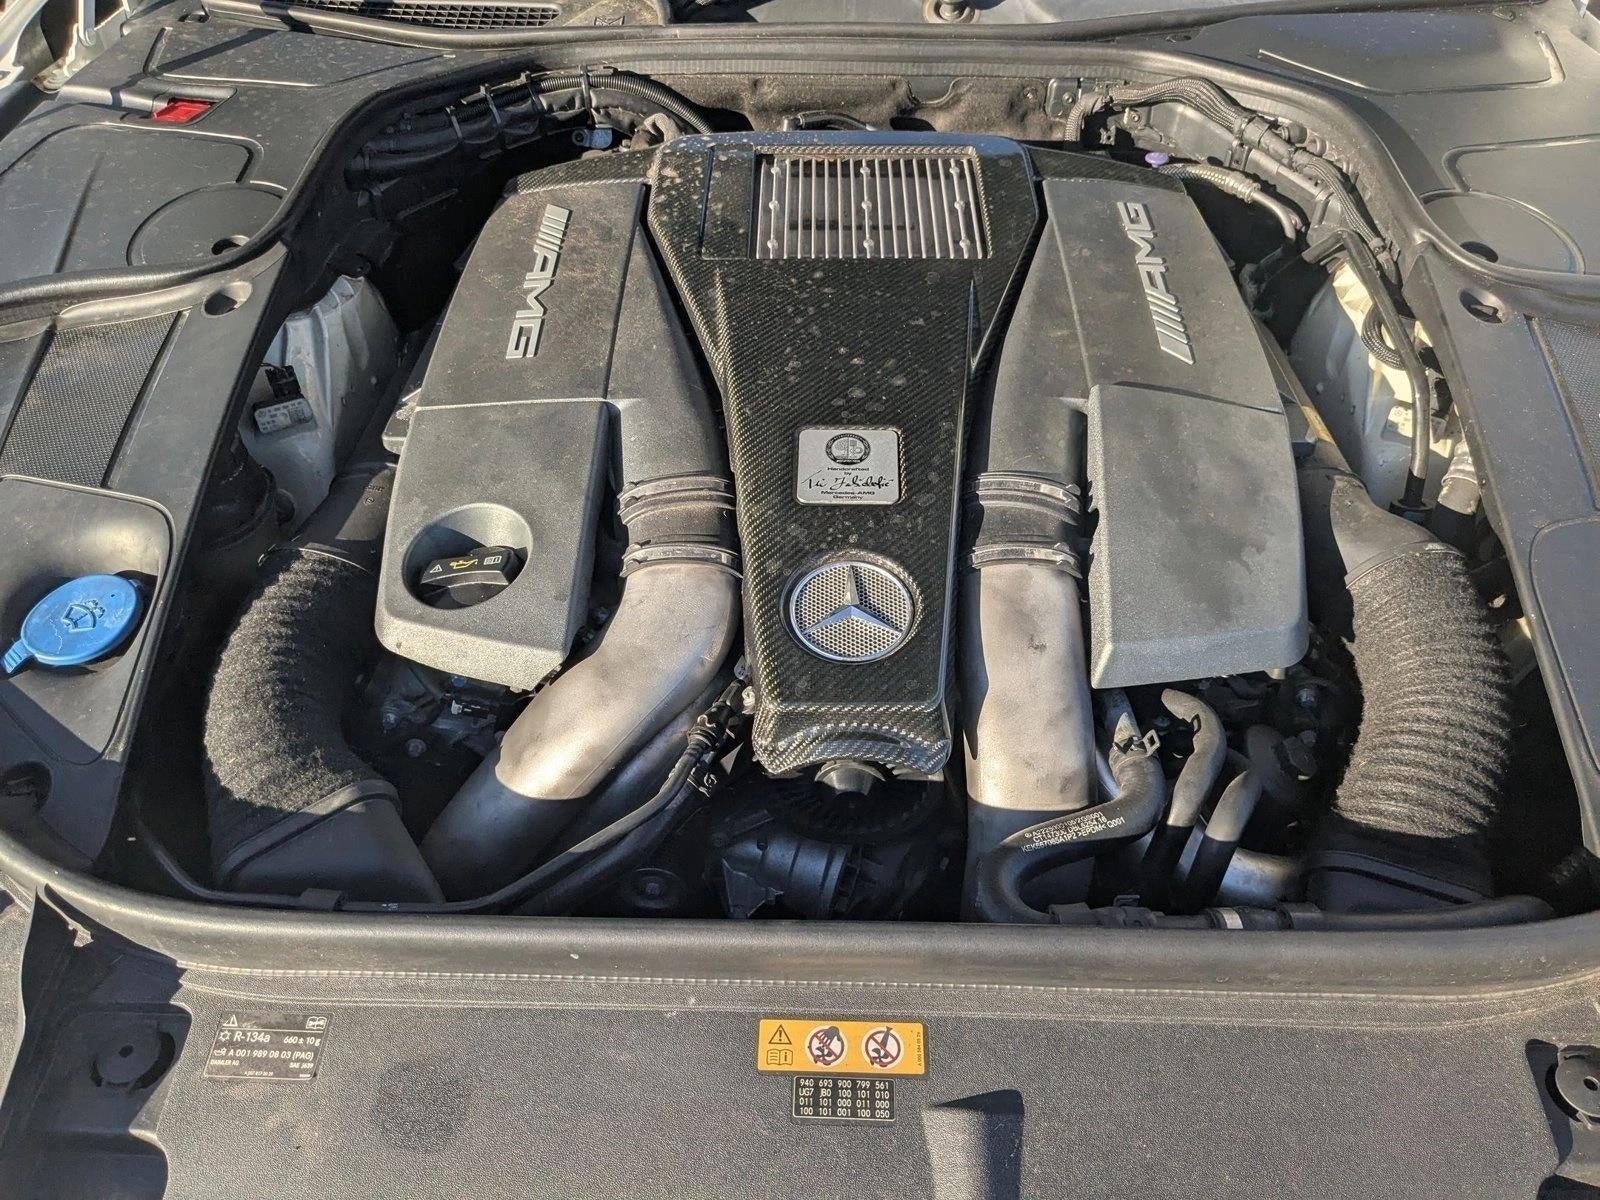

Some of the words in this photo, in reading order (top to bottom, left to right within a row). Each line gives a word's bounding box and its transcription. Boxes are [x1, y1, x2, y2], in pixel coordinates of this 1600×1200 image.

[1117, 201, 1177, 305] AMG
[505, 245, 561, 359] AMG
[233, 1032, 271, 1043] R-134a
[227, 1049, 234, 1057] A
[236, 1049, 250, 1057] 001
[252, 1050, 267, 1058] 989
[269, 1050, 280, 1058] 08
[281, 1051, 291, 1059] 03
[292, 1051, 314, 1061] (PAG)
[800, 1078, 814, 1087] 940
[818, 1079, 833, 1088] 693
[837, 1080, 852, 1088] 900
[856, 1080, 870, 1088] 799
[875, 1081, 889, 1089] 561
[799, 1088, 814, 1096] UG7
[838, 1089, 851, 1097] 100
[857, 1090, 870, 1098] 101
[875, 1091, 890, 1099] 010
[799, 1098, 813, 1106] 011
[819, 1098, 832, 1106] 101
[837, 1099, 851, 1107] 000
[856, 1100, 870, 1108] 011
[875, 1100, 890, 1108] 000
[800, 1107, 814, 1115] 100
[819, 1107, 832, 1115] 101
[837, 1108, 851, 1116] 001
[857, 1109, 870, 1117] 100
[875, 1110, 890, 1118] 050
